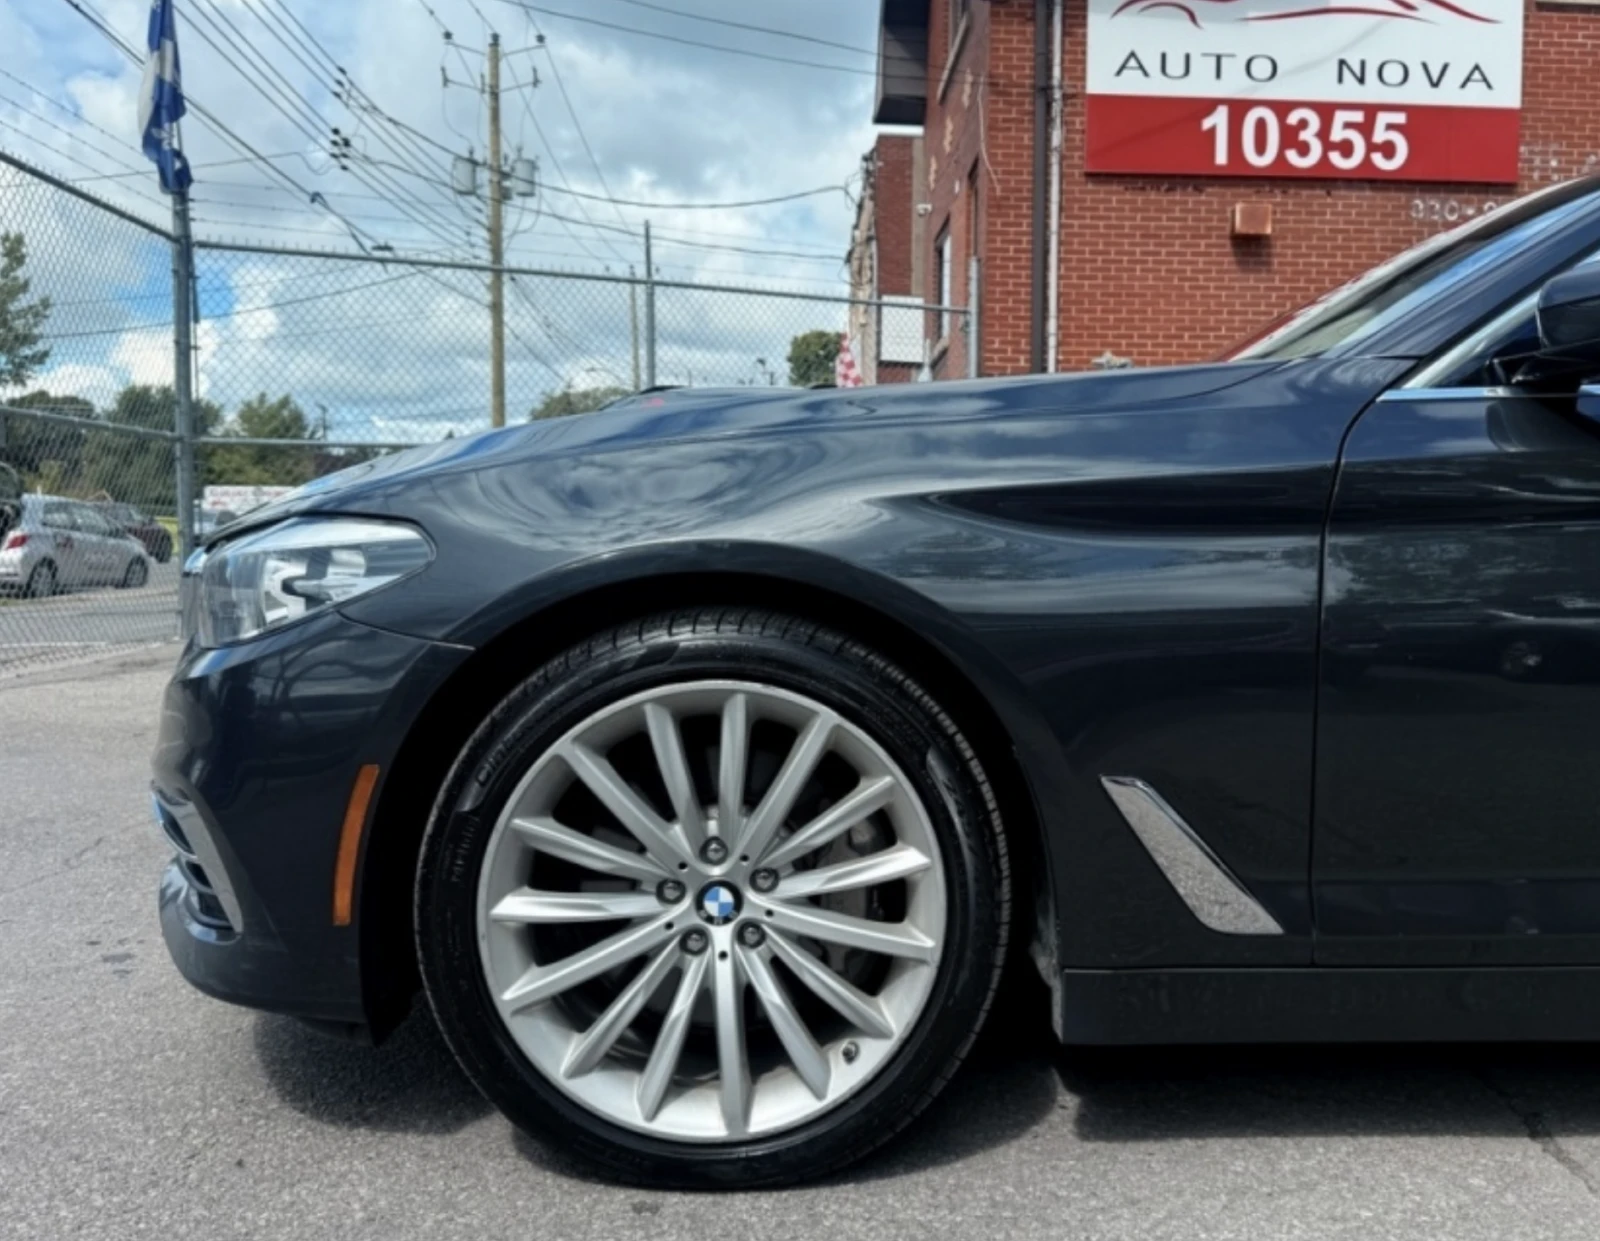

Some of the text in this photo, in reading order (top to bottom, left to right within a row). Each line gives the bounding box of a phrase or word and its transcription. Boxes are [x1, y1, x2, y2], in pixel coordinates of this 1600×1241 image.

[1113, 49, 1494, 91] AUTO NOVA
[1201, 104, 1410, 171] 10355
